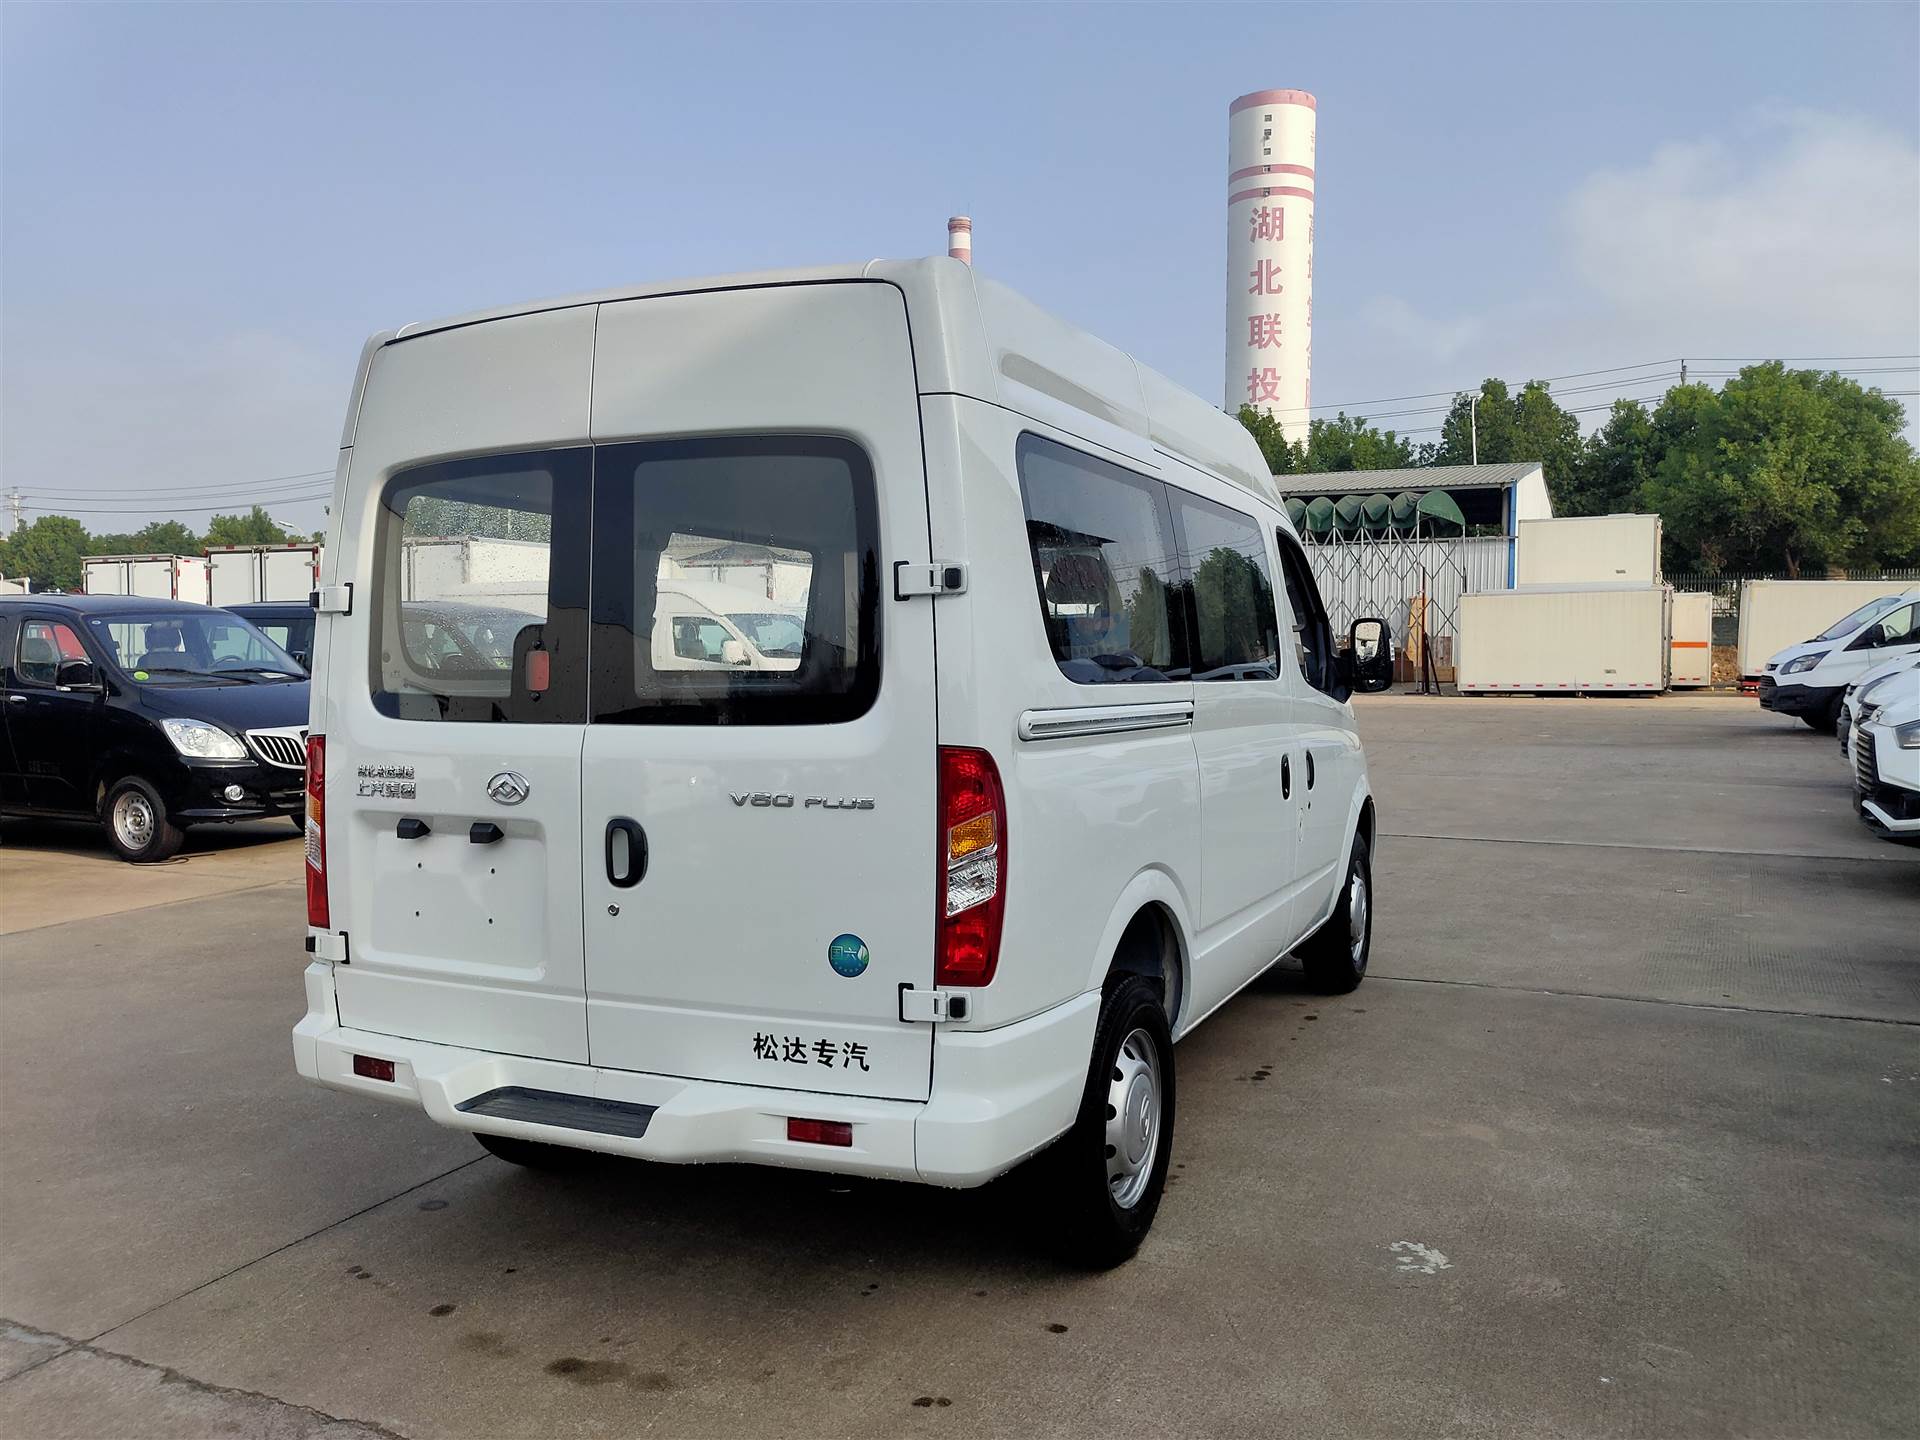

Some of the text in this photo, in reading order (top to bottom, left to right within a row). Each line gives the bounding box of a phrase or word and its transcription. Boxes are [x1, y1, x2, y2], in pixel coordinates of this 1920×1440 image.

[1247, 206, 1285, 404] 湖北联投
[804, 795, 876, 810] PLUS
[753, 1032, 871, 1073] 松达专汽
